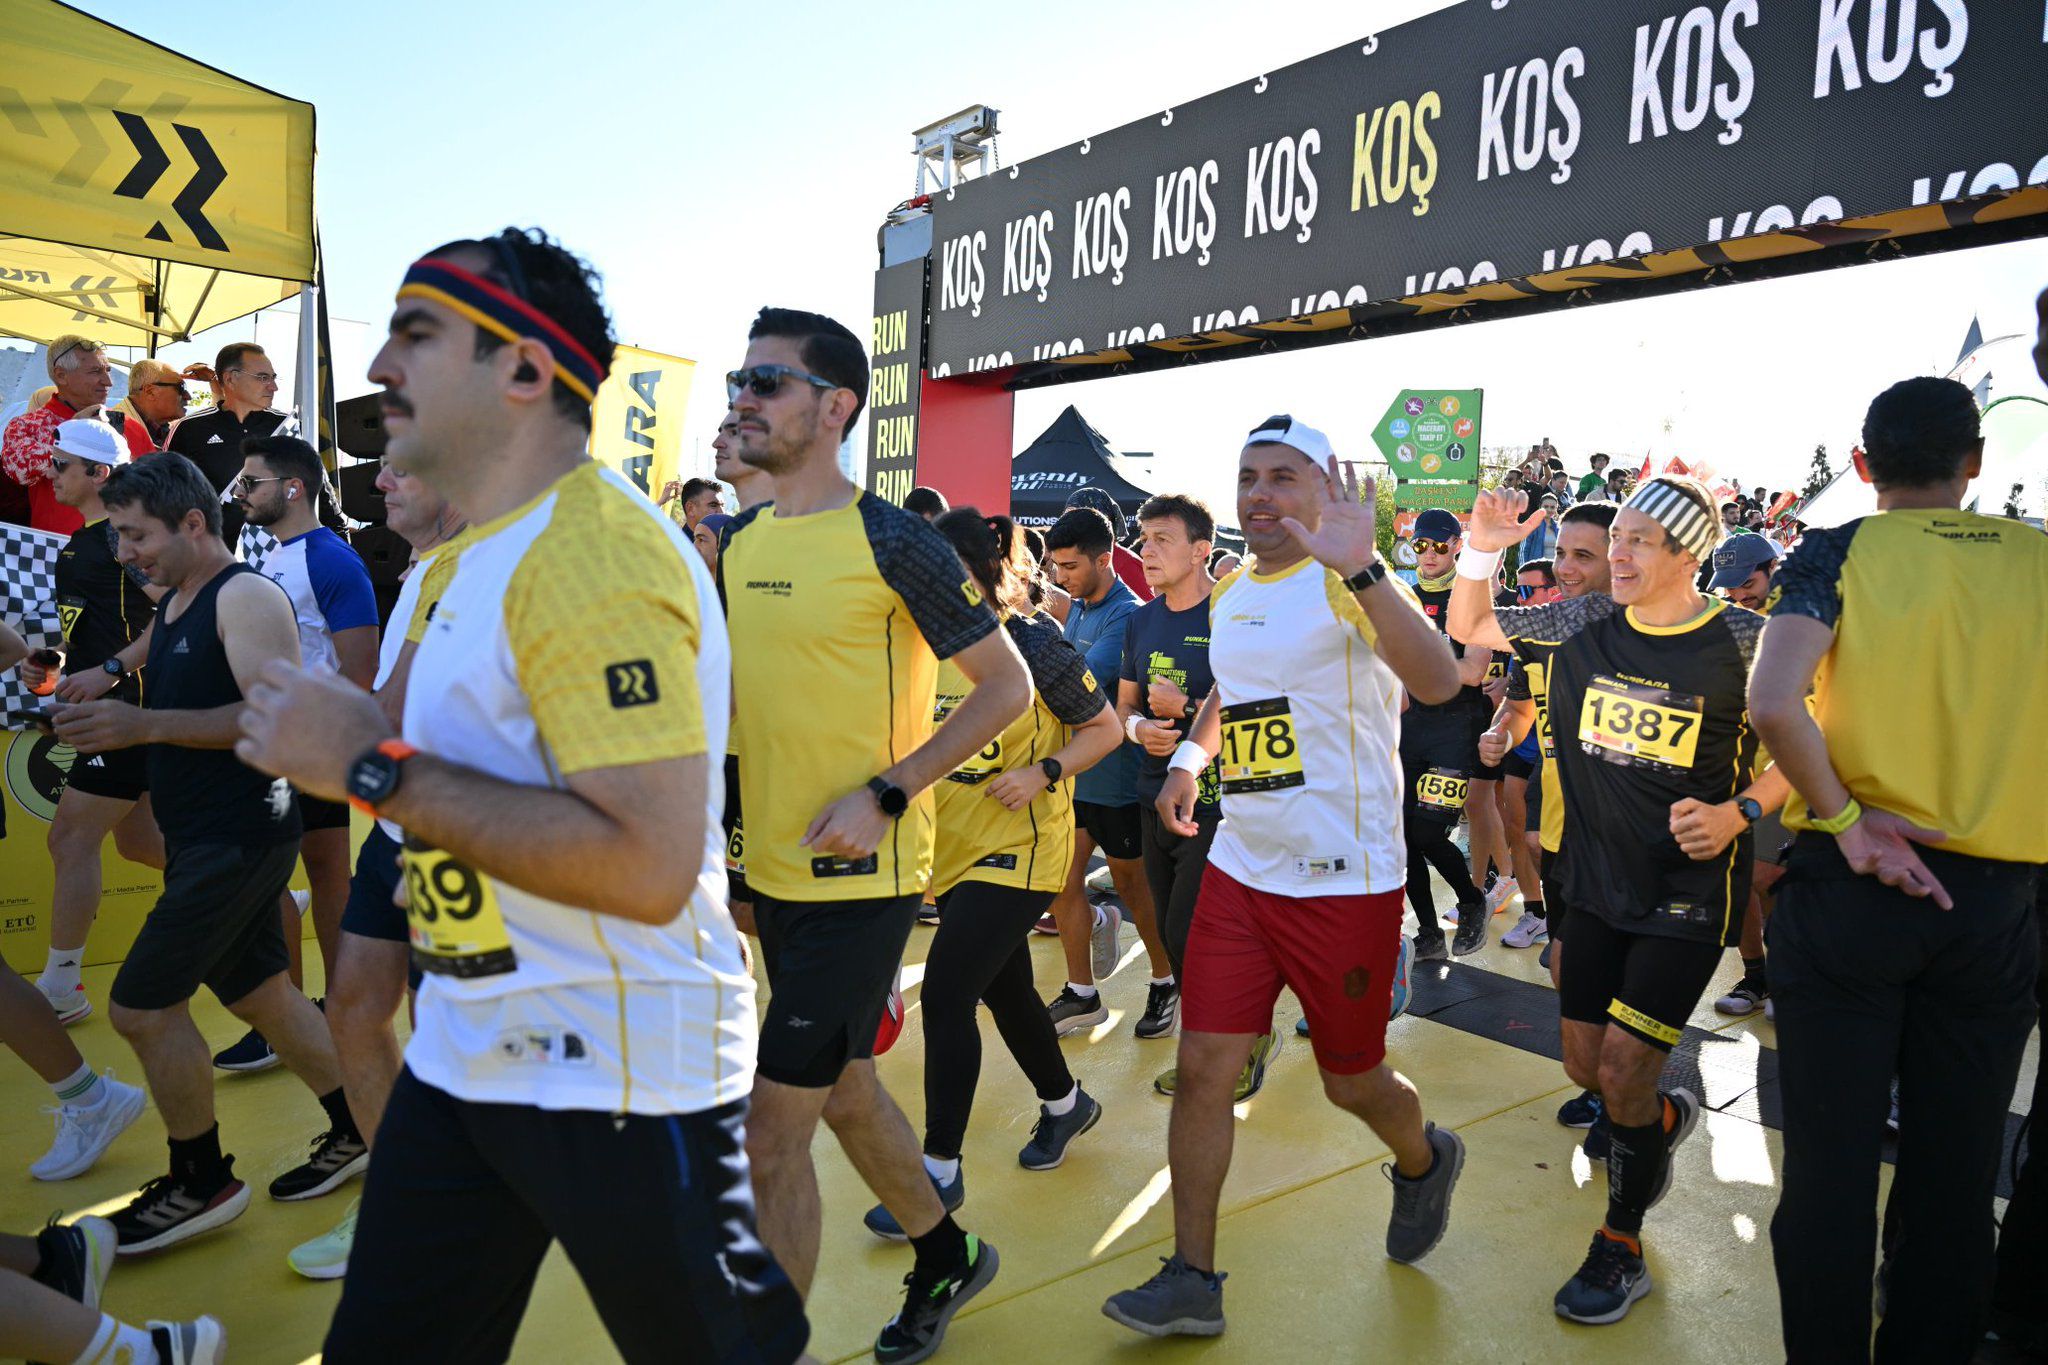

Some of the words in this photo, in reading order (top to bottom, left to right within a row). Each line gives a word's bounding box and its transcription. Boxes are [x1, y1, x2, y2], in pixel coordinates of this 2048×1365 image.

[942, 230, 987, 317] KOŞ
[1003, 209, 1054, 302] KOŞ
[1073, 186, 1131, 286] KOŞ
[1152, 159, 1219, 266] KOŞ
[1244, 128, 1322, 243] KOŞ
[1351, 90, 1441, 217] KOŞ
[1477, 46, 1585, 185] KOŞ
[1628, 0, 1760, 146] KOŞ
[872, 310, 908, 356] RUN
[871, 363, 909, 409] RUN
[876, 415, 914, 459] RUN
[1220, 719, 1295, 766] 178
[1590, 696, 1695, 748] 1387
[1420, 776, 1468, 800] 1580
[5, 914, 36, 929] ETÜ
